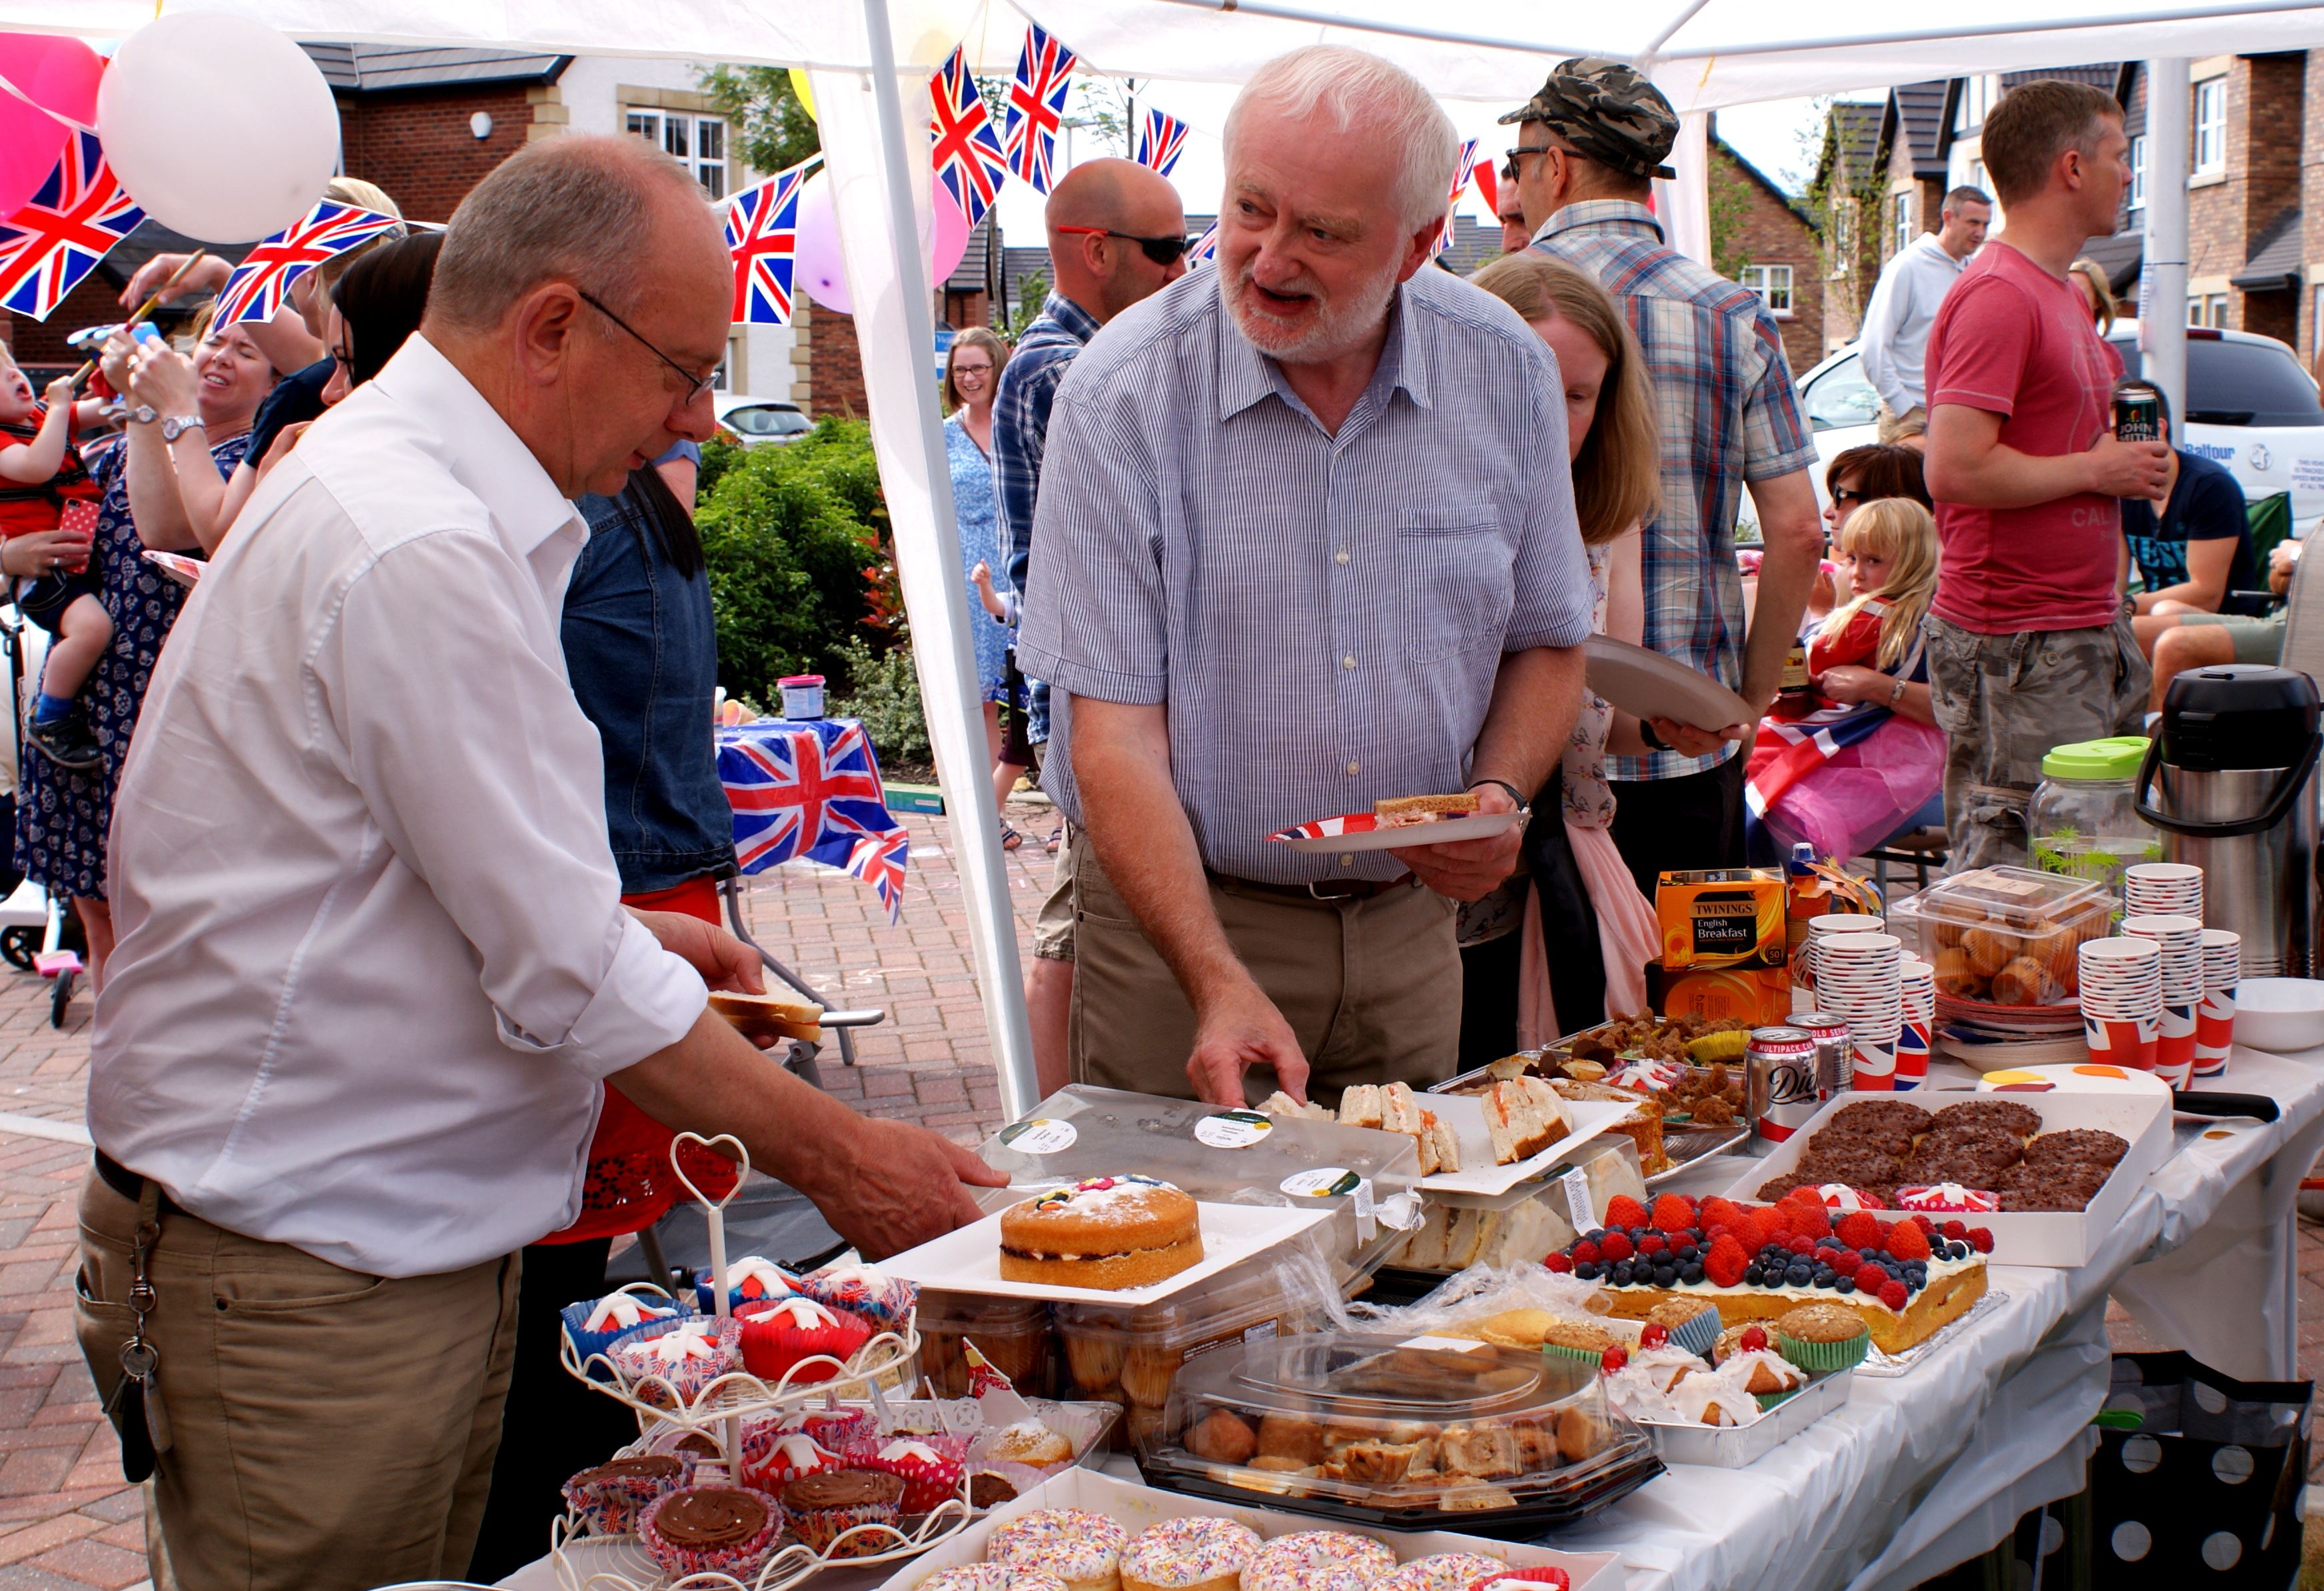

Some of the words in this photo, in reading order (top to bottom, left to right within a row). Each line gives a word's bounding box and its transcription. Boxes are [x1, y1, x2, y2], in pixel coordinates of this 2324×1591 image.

[2120, 423, 2154, 434] JOHN
[2185, 443, 2235, 459] Balfour
[1695, 904, 1753, 915] TWININGS
[1697, 919, 1727, 928] English
[1698, 928, 1747, 939] Breakfast
[1769, 950, 1779, 958] 50
[1812, 1030, 1826, 1038] OLD
[1758, 1044, 1801, 1053] MULTIPACK
